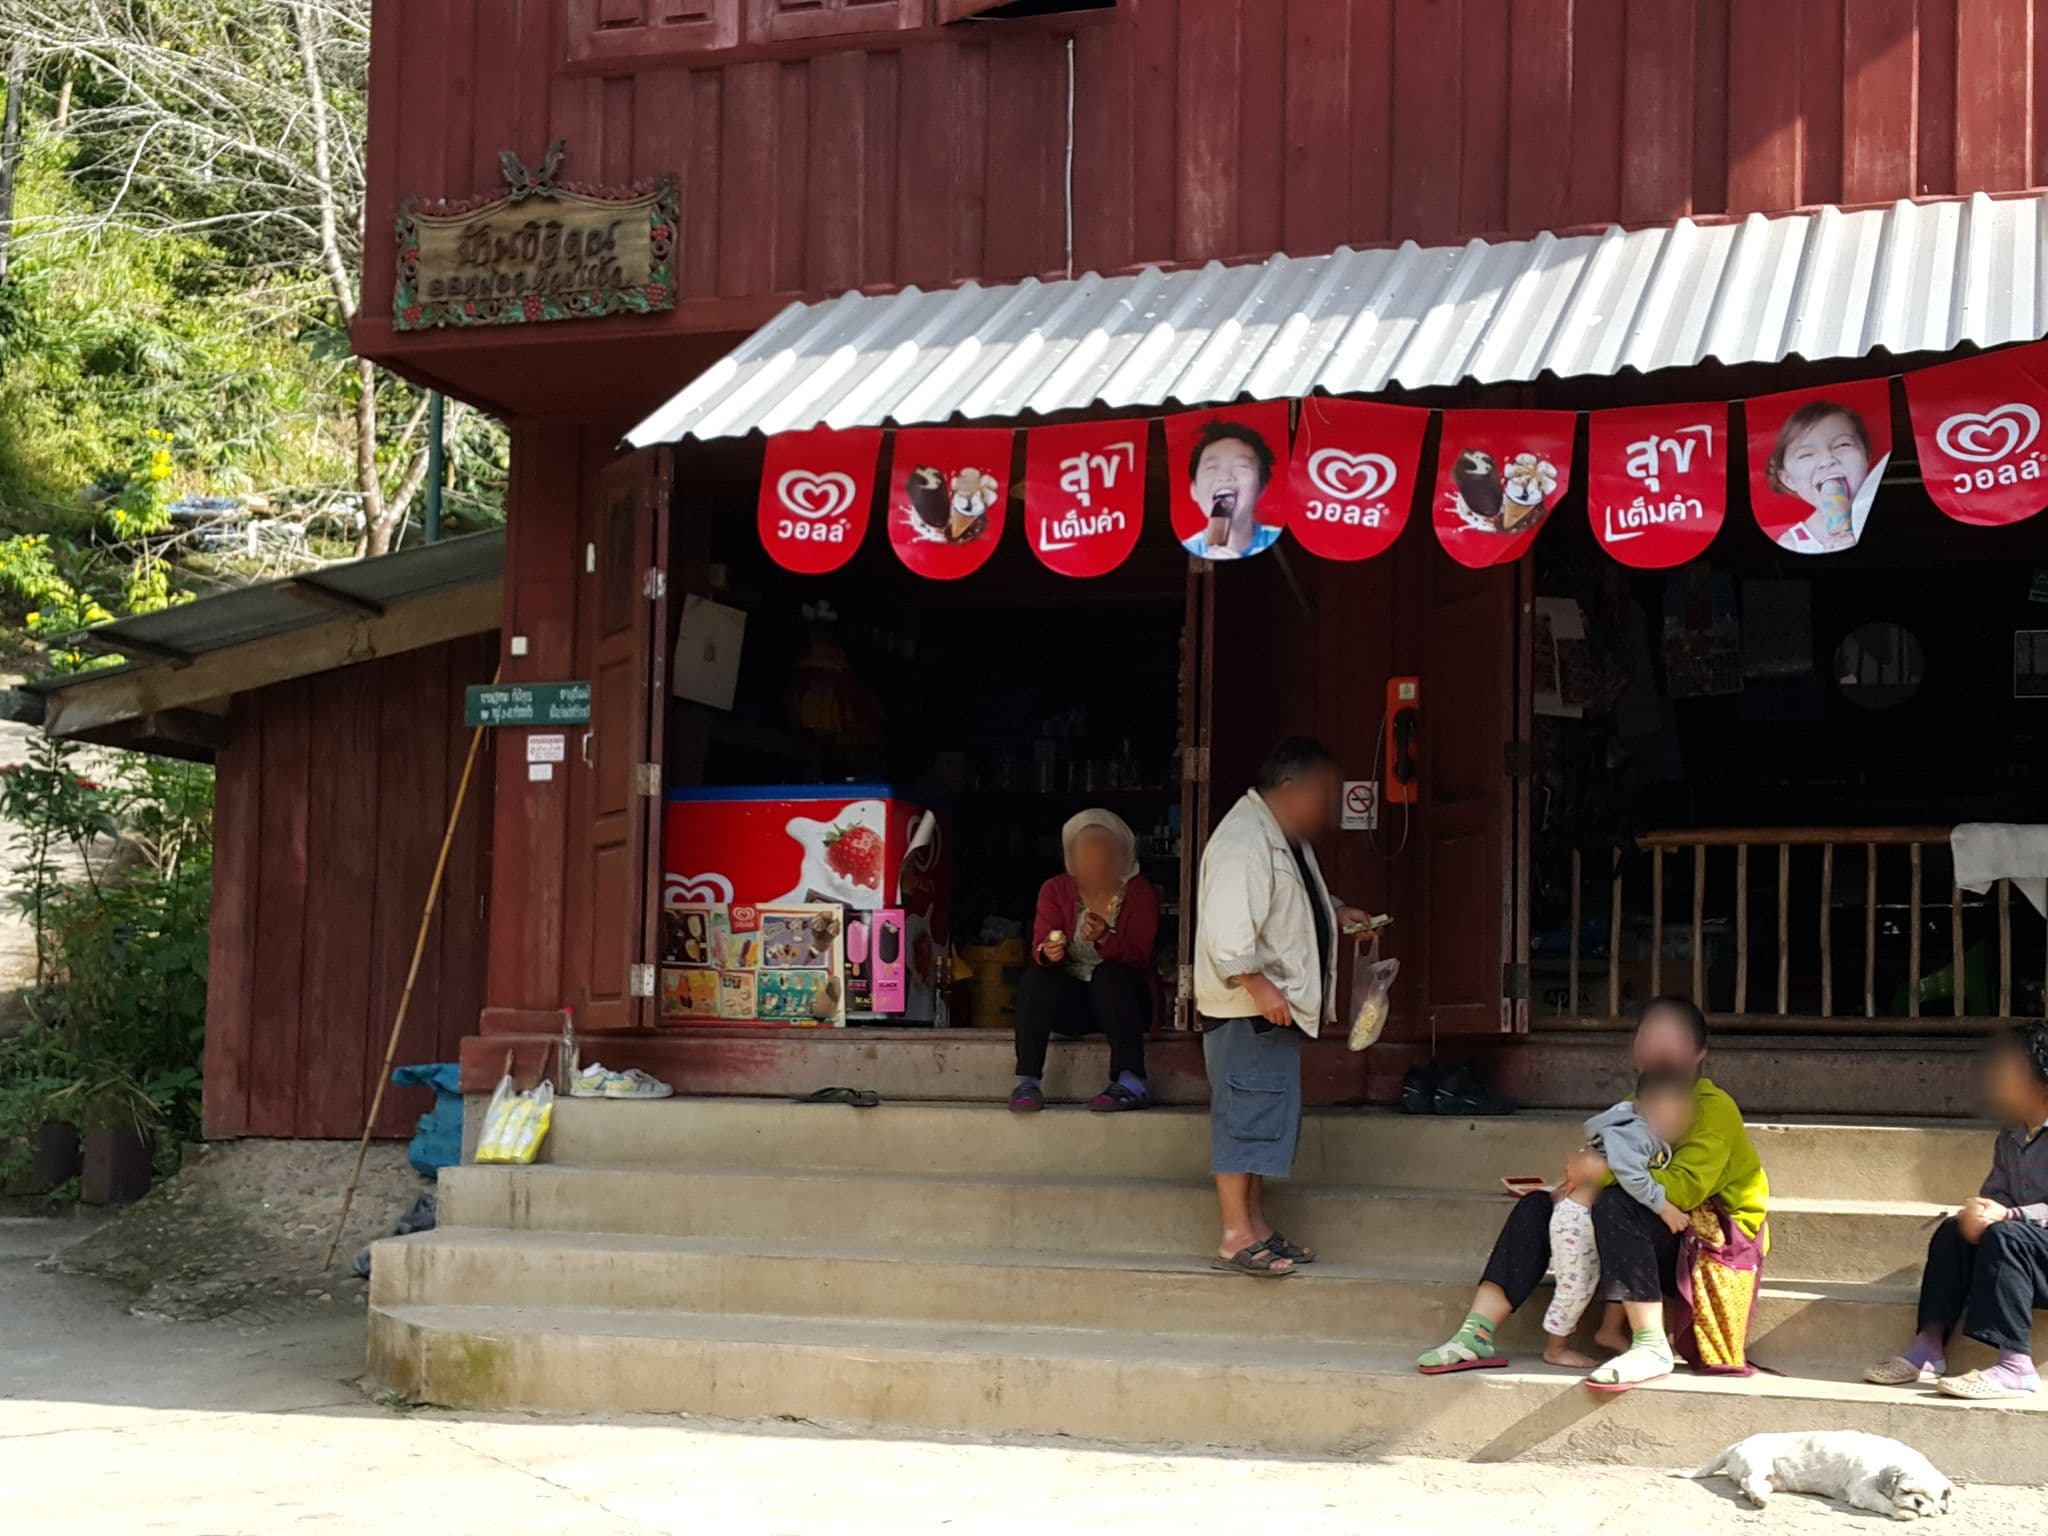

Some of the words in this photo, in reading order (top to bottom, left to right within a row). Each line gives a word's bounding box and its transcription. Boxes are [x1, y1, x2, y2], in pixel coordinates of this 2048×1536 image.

[1059, 451, 1121, 507] สุข
[1625, 435, 1697, 493] สุข
[1953, 451, 2041, 494] วอลล์
[1052, 507, 1126, 540] เต็มคำ
[1305, 500, 1385, 528] วอลล์
[1618, 493, 1703, 529] เต็มคำ
[777, 518, 846, 543] วอลล์
